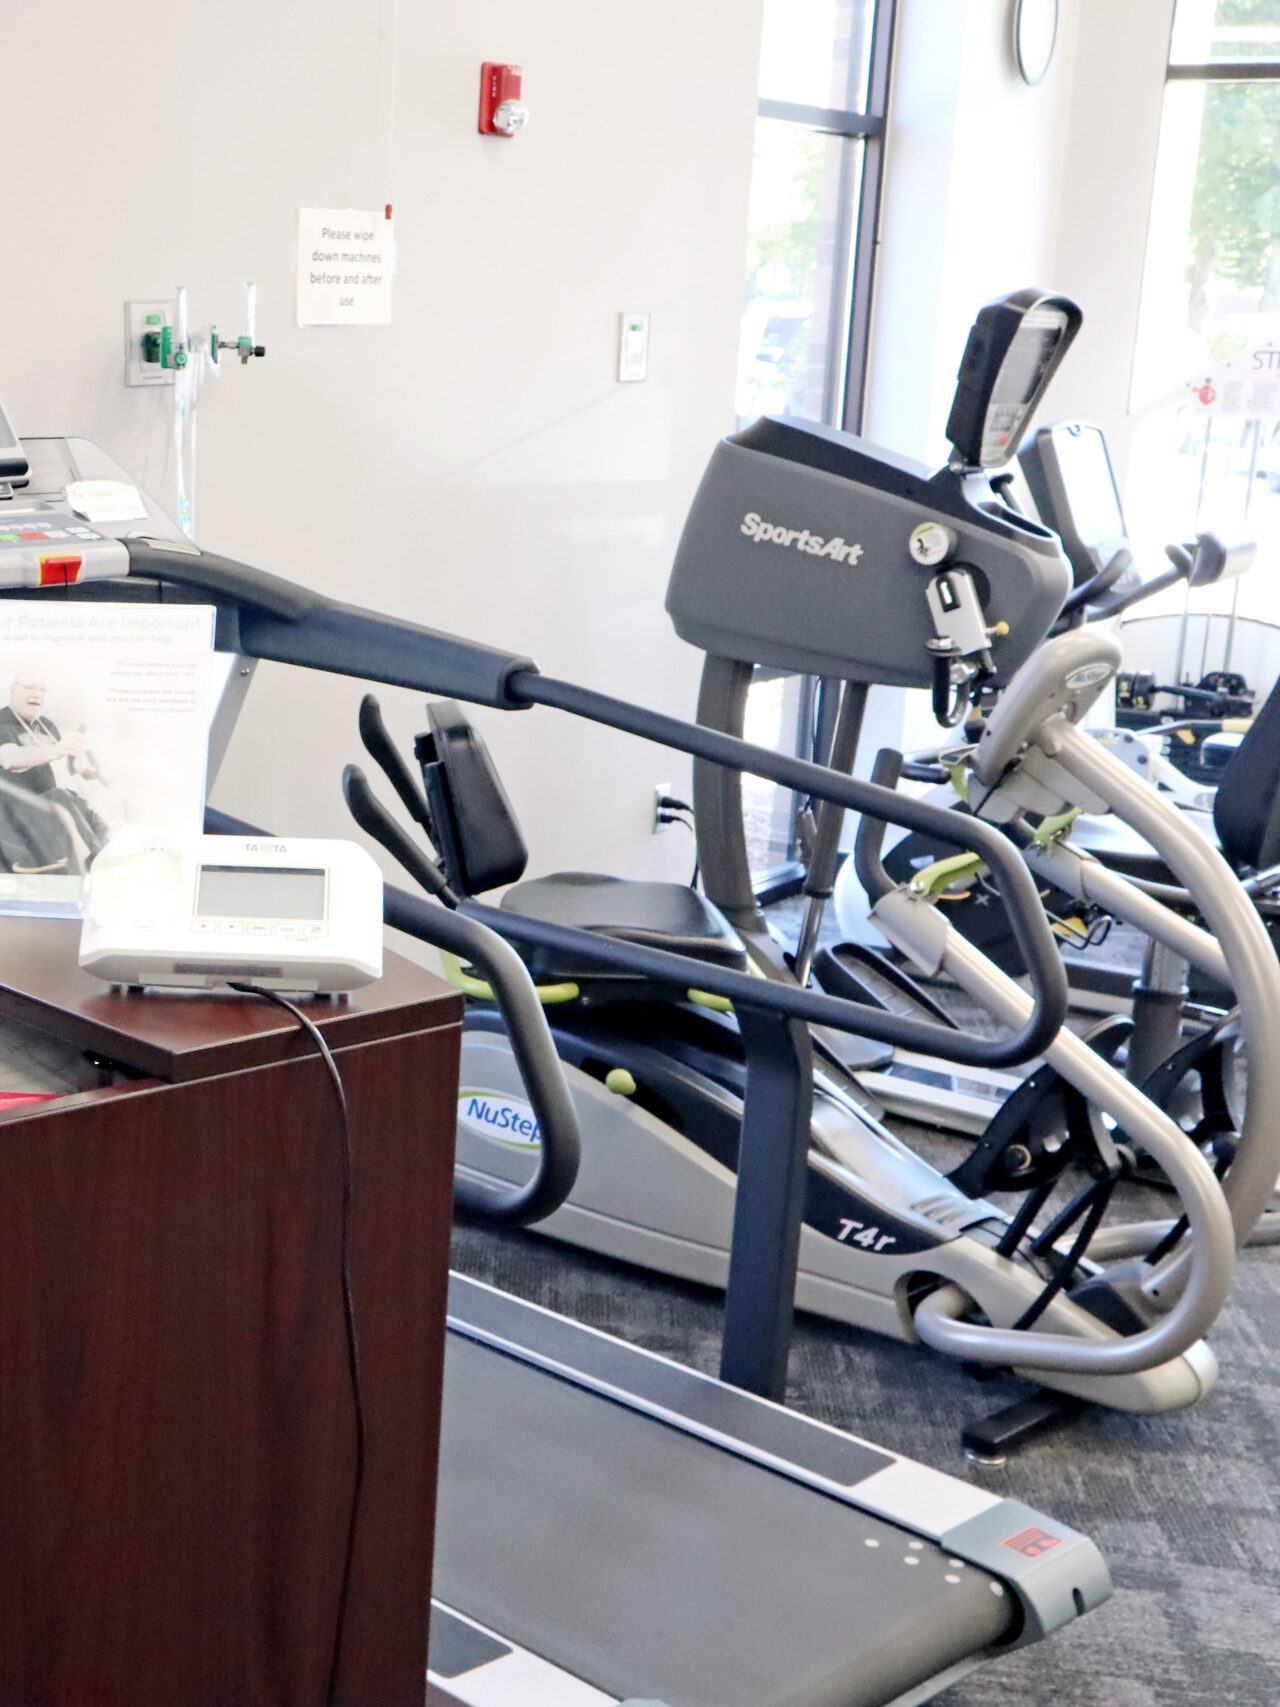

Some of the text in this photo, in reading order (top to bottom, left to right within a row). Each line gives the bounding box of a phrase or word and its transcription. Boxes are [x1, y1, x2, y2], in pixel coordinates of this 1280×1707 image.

[322, 228, 374, 241] Please wipe
[311, 249, 381, 263] down machines
[309, 271, 382, 285] before and after
[339, 297, 354, 306] use
[1251, 350, 1280, 370] ST
[740, 512, 864, 566] SportsArt
[18, 614, 83, 629] Patients
[87, 616, 118, 630] Are
[120, 616, 202, 633] Important
[245, 843, 288, 853] TATA
[467, 1098, 543, 1143] NuStep
[837, 1218, 897, 1252] T4r
